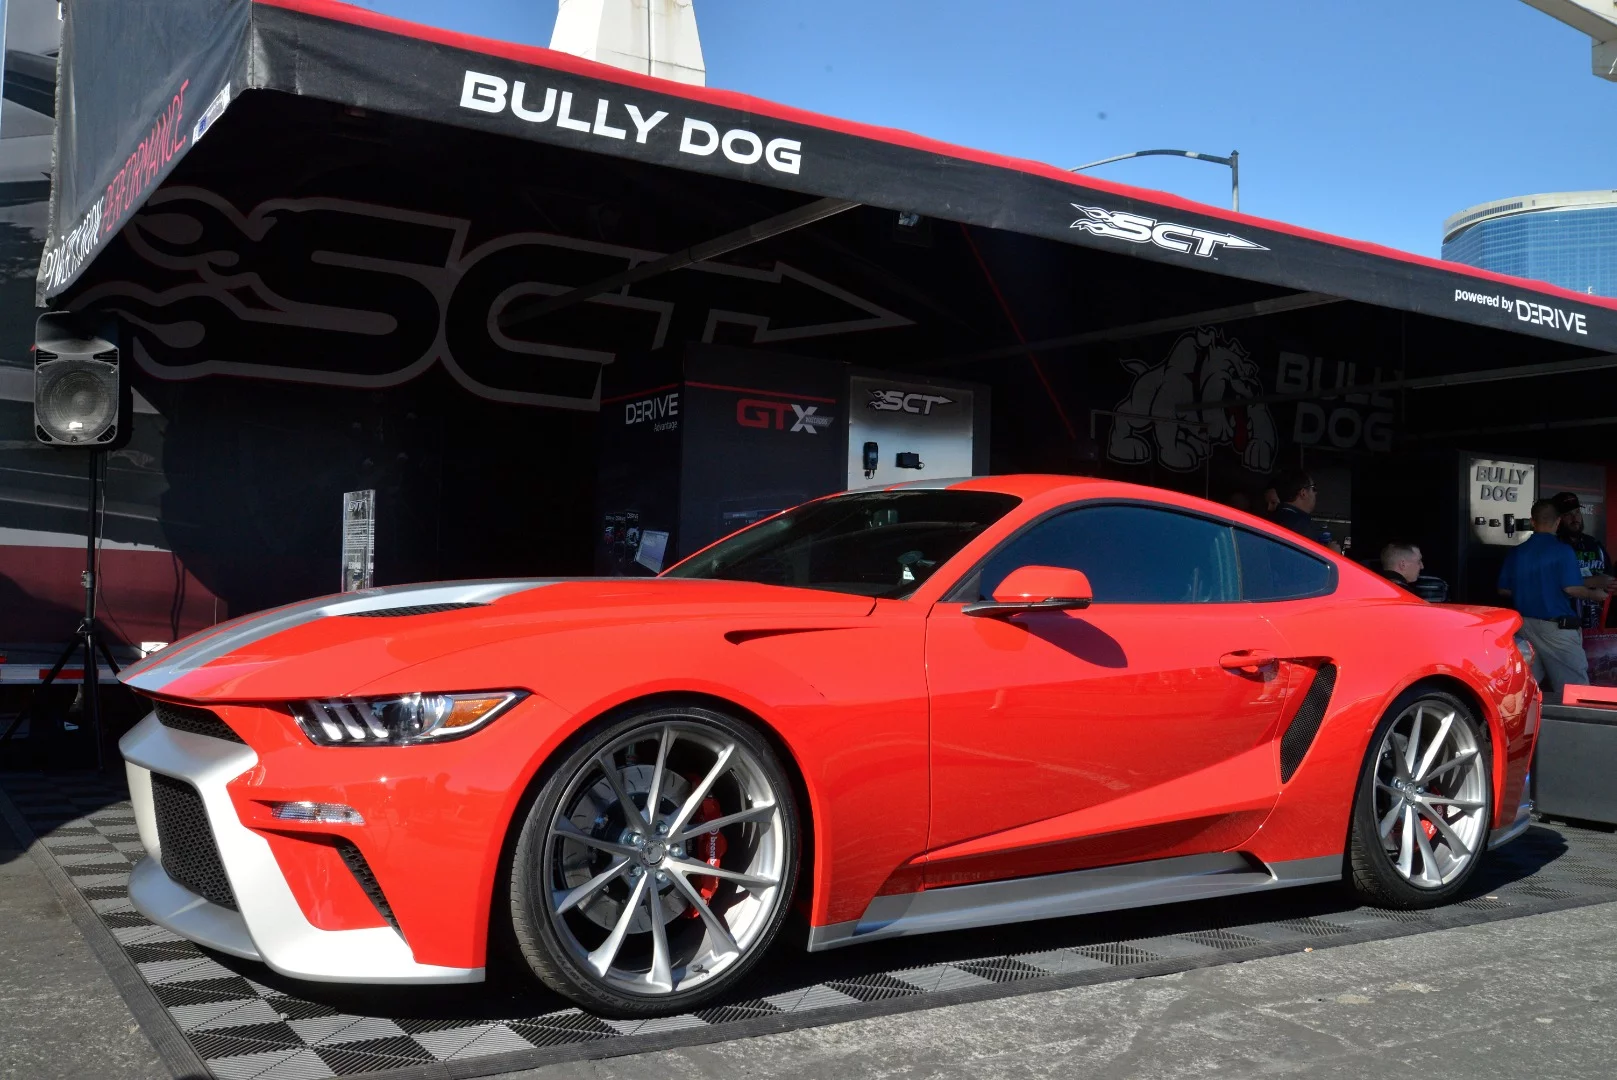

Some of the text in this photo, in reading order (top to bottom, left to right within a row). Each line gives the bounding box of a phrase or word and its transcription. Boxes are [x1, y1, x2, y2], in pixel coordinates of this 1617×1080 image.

[459, 70, 802, 175] BULLY DOG
[1082, 204, 1264, 258] SCT
[1455, 289, 1588, 335] powered by DERIVE
[625, 393, 679, 425] DERIVE
[737, 399, 818, 434] GTX
[870, 390, 953, 415] SCT
[653, 420, 678, 432] Advantage
[1293, 402, 1395, 452] DOG
[1476, 466, 1528, 485] BULLY
[1480, 484, 1518, 502] DOG
[709, 836, 718, 867] bremb
